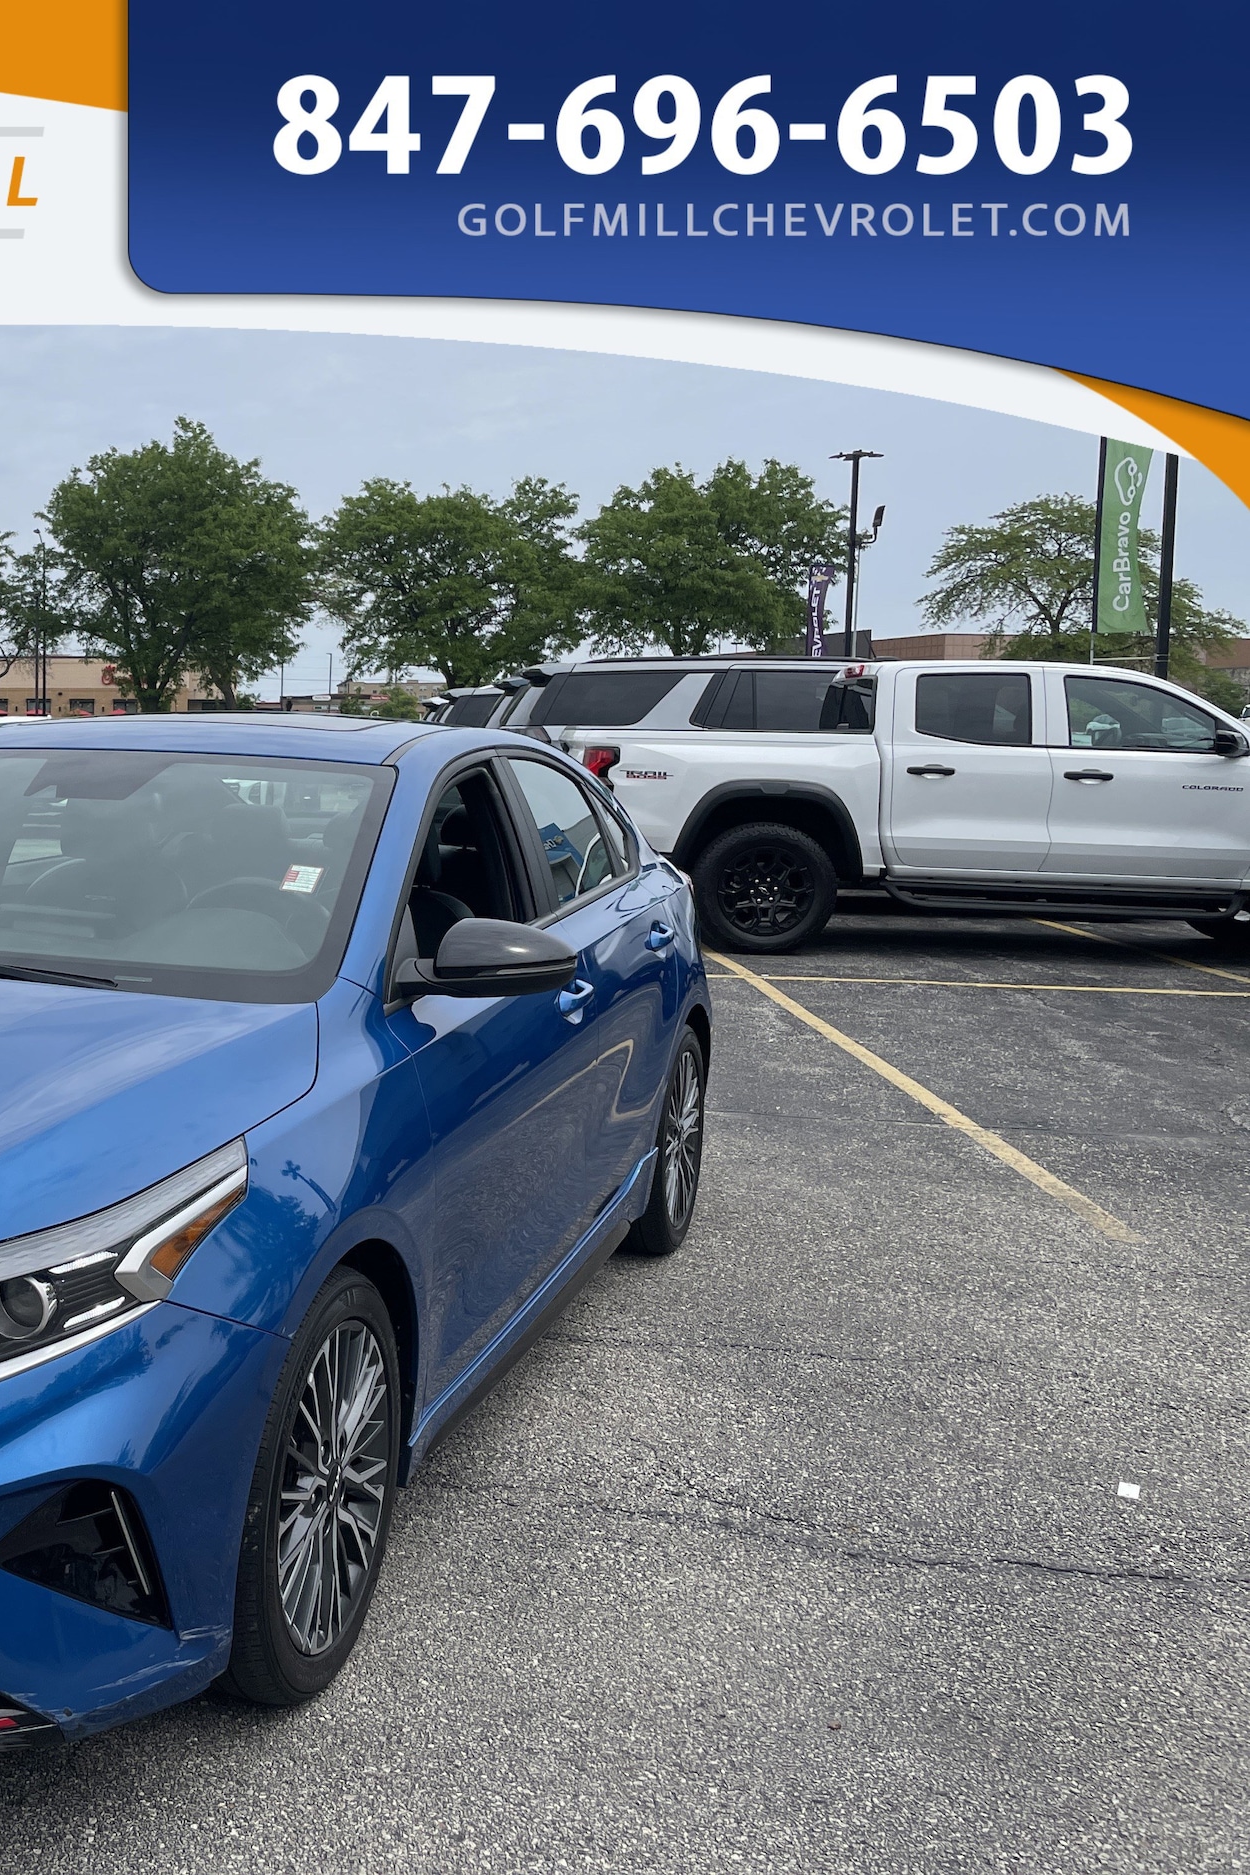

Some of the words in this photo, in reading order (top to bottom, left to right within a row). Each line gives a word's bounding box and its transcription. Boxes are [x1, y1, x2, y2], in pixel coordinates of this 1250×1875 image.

[1112, 511, 1132, 612] CarBravo
[811, 587, 824, 657] EVROLET
[1181, 784, 1244, 792] COLORADO
